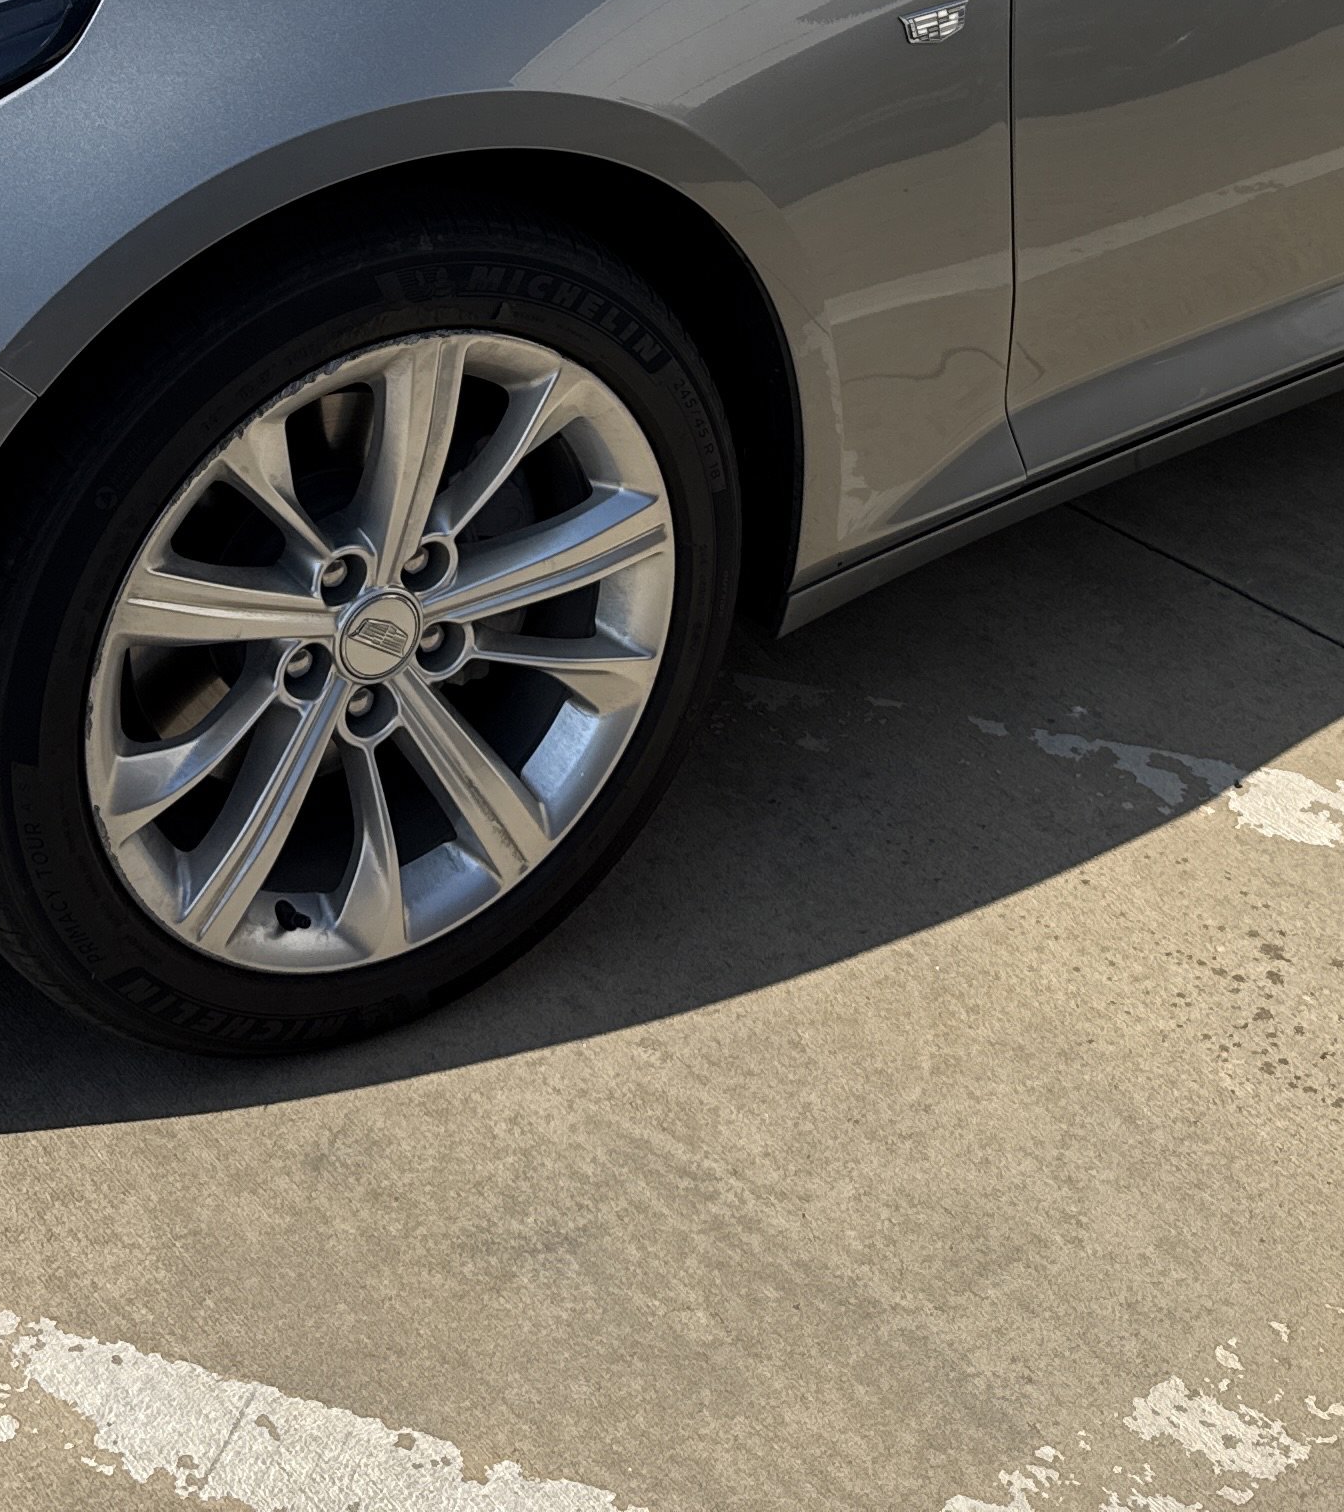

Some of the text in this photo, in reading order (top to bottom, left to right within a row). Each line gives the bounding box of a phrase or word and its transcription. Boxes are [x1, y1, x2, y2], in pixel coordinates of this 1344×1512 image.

[463, 264, 664, 367] MICHELIN
[673, 378, 721, 480] 245/45 R 18
[24, 822, 52, 881] TOUR
[44, 889, 106, 964] PRIMACY
[118, 975, 349, 1042] MICHELIN
